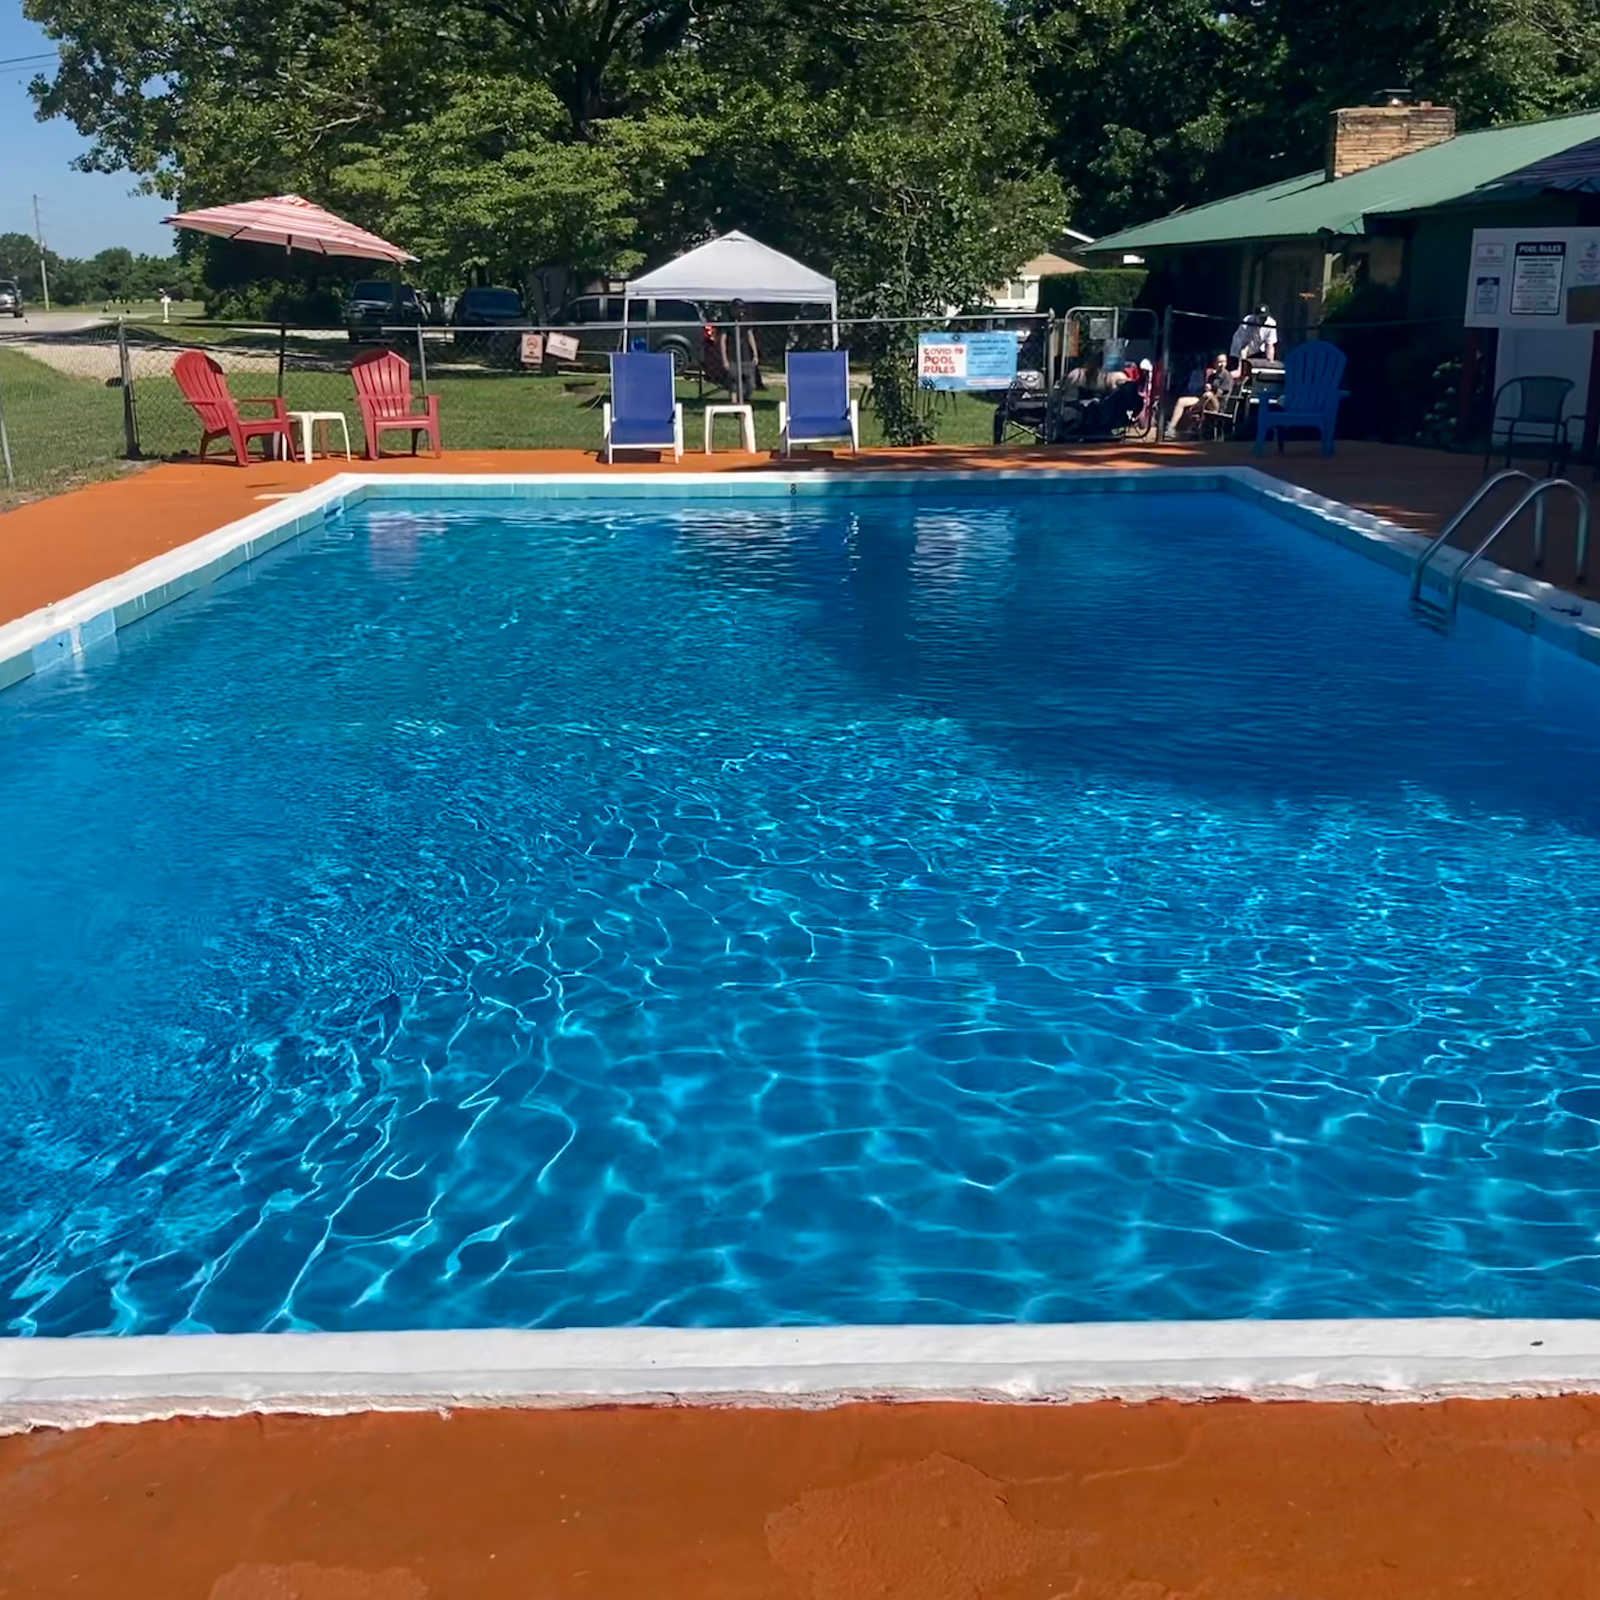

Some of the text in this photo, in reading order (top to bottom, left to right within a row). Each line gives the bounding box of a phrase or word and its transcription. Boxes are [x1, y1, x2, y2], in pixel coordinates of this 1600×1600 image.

[924, 356, 954, 364] POOL
[923, 366, 956, 374] RULES
[790, 483, 796, 495] 8
